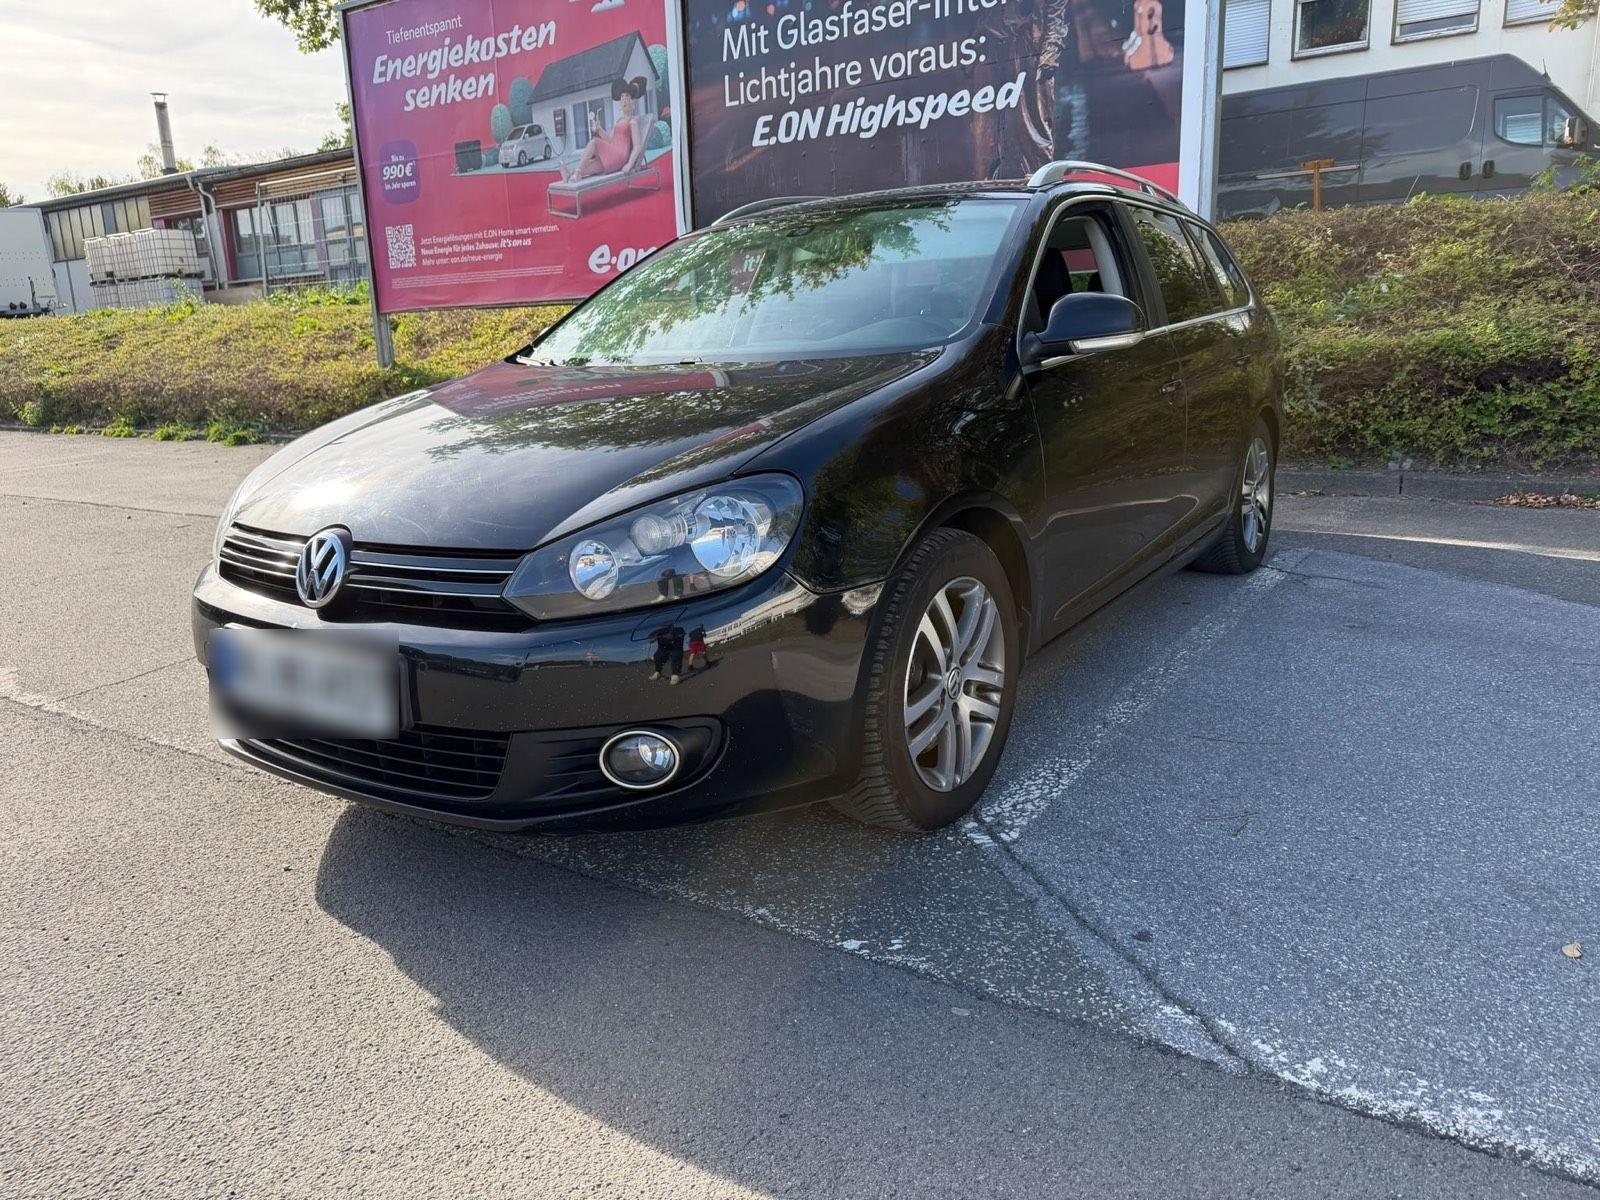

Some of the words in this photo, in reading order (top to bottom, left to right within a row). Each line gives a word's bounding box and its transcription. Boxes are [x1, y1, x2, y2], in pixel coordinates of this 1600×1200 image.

[386, 15, 462, 45] Tiefenentspannt
[722, 22, 769, 62] Mit
[373, 20, 556, 84] Energiekosten
[724, 57, 862, 107] Lichtjahre
[870, 36, 986, 81] voraus:
[404, 73, 494, 112] senken
[752, 106, 825, 147] E.ON
[826, 72, 1026, 139] Highspeed
[515, 226, 531, 235] smart
[523, 238, 532, 246] us
